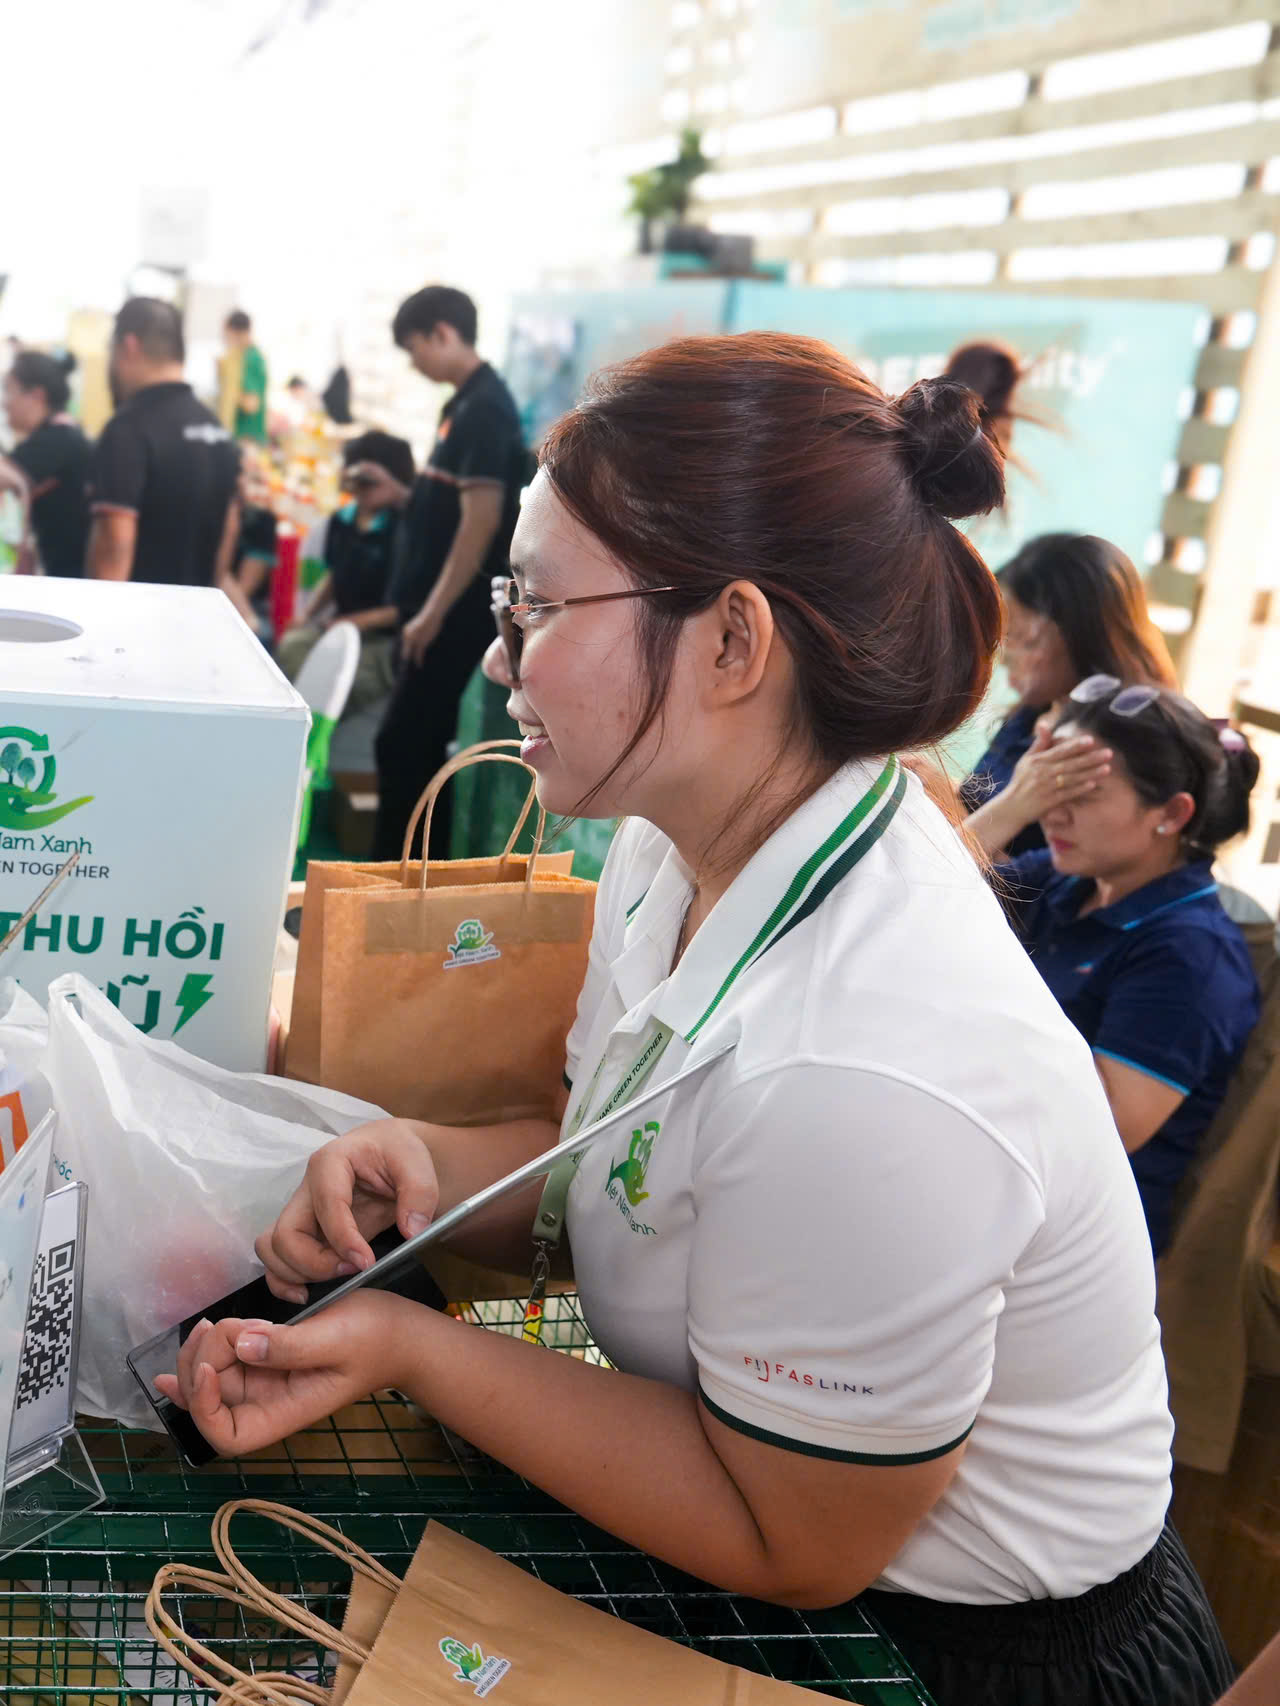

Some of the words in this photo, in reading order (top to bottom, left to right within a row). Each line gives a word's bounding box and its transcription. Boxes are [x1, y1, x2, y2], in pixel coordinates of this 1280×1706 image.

[40, 834, 92, 855] Xanh
[122, 906, 226, 961] HỒI
[613, 1076, 633, 1104] GREEN
[631, 1032, 664, 1079] TOGETHER
[775, 1363, 873, 1395] FASLINK
